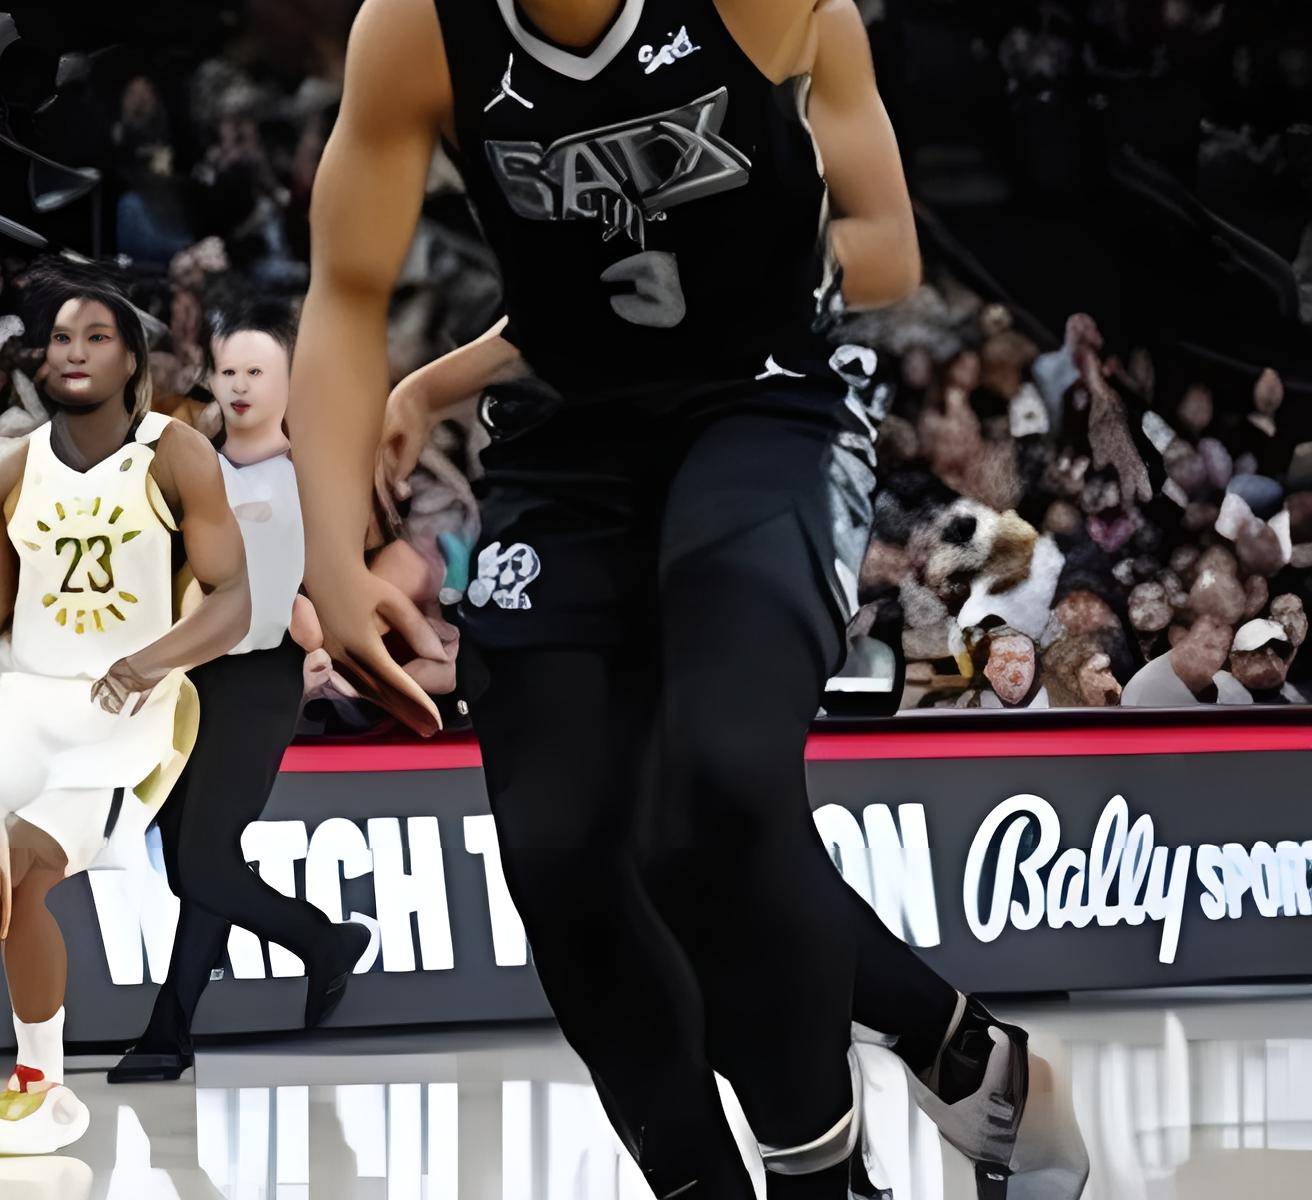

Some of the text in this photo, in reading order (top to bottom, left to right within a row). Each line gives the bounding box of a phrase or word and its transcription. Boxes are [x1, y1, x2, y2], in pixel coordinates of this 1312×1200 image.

[600, 250, 687, 328] 3
[55, 535, 114, 593] 23
[963, 793, 1191, 964] Bally
